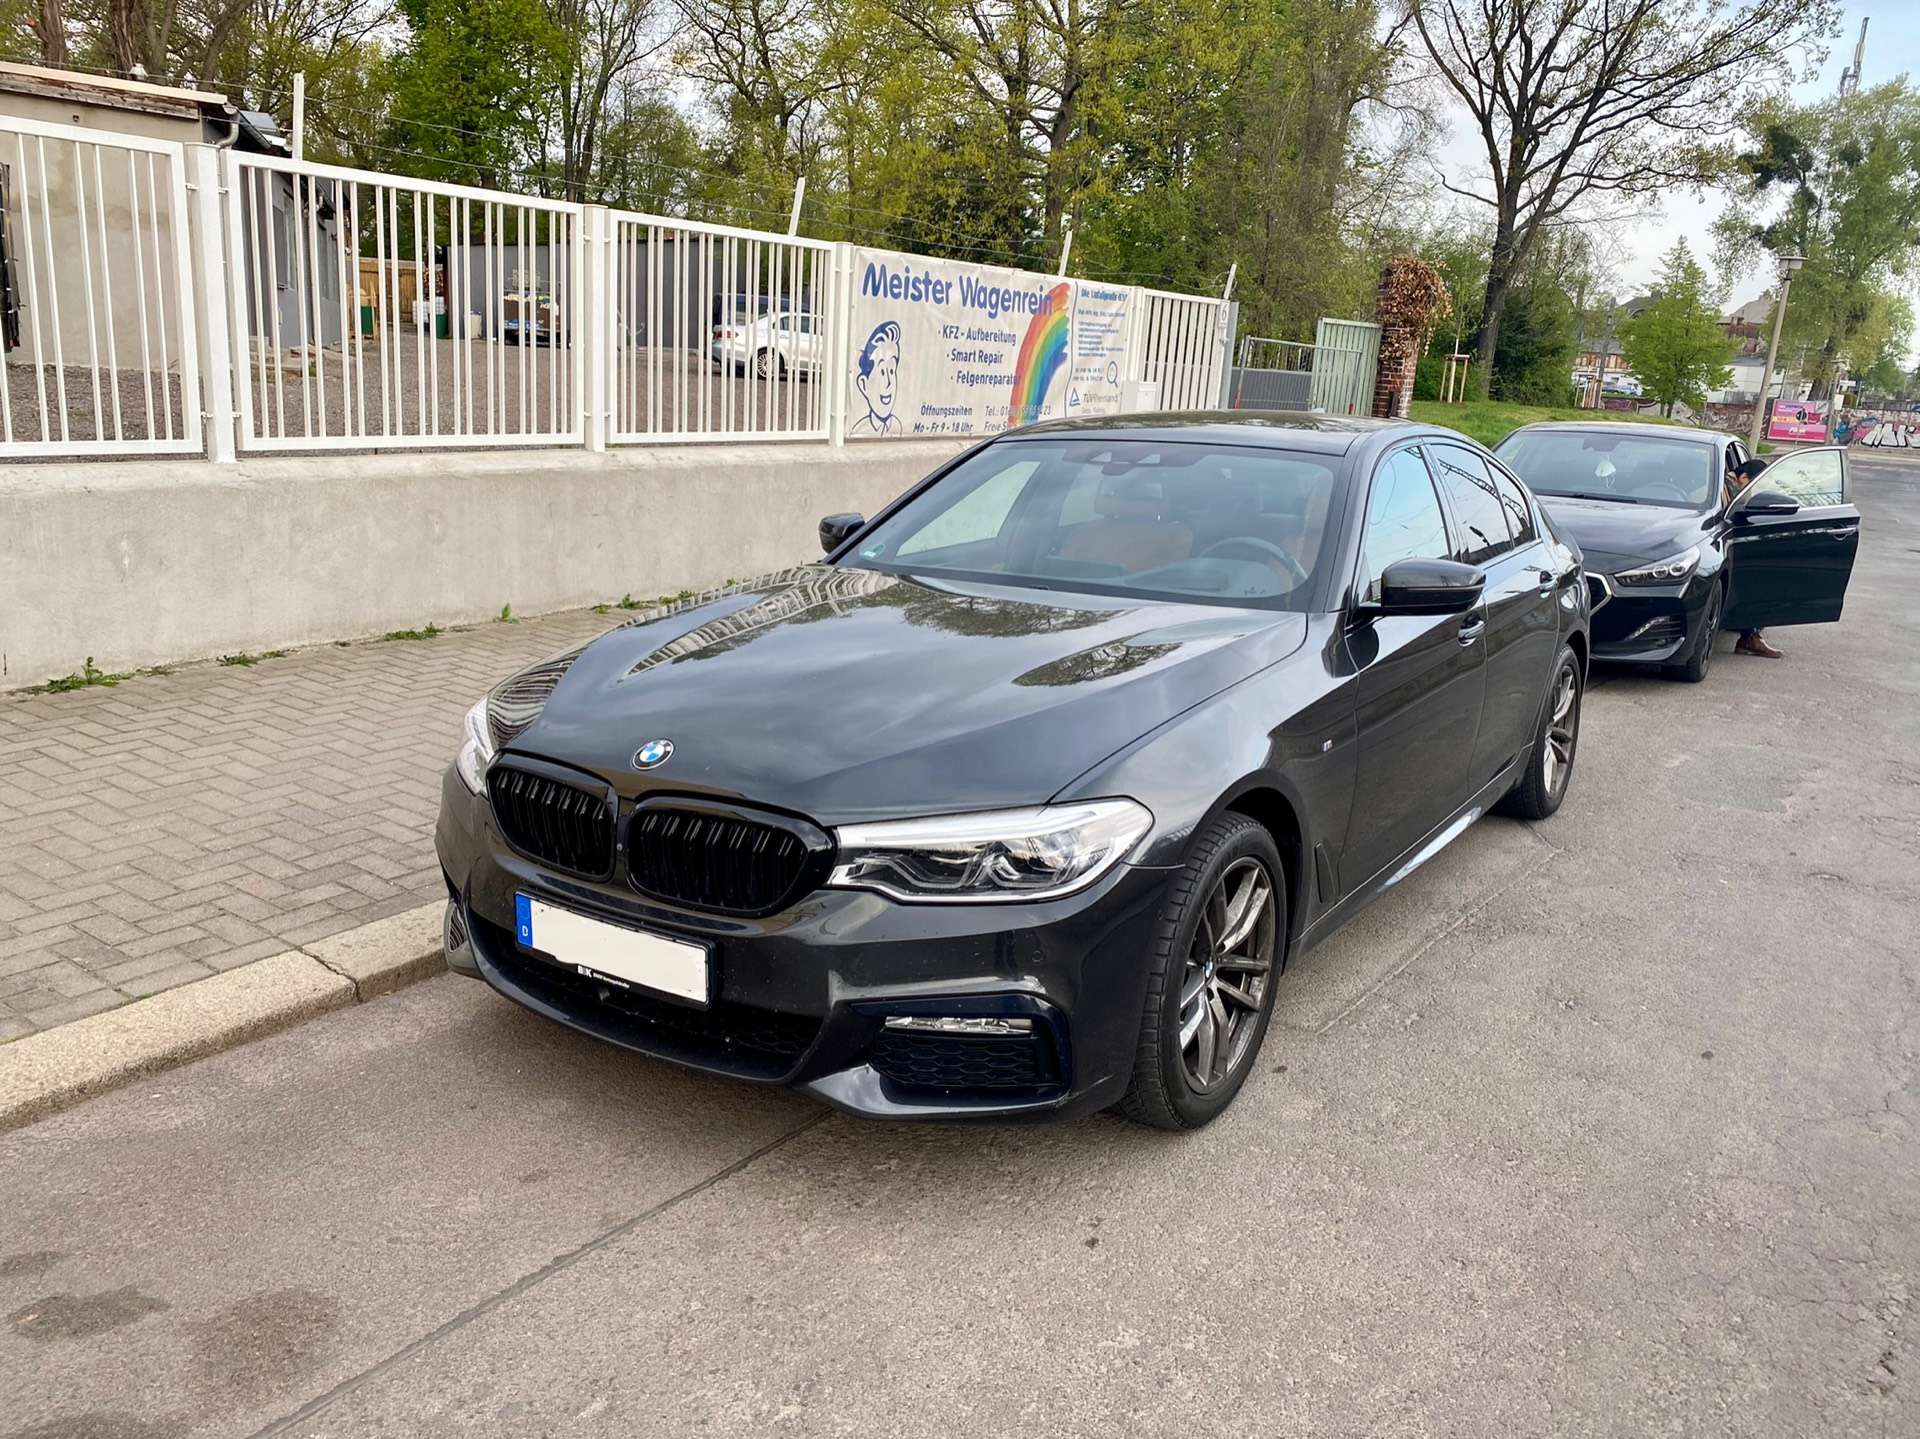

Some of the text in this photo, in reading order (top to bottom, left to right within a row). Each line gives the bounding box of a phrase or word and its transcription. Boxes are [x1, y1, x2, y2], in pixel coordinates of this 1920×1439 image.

[862, 262, 1053, 319] Meister Wagenrein
[942, 324, 960, 340] KFZ
[966, 327, 1017, 346] Aufbereitung
[951, 348, 1003, 366] Smart Repair
[913, 422, 925, 432] Mo
[930, 422, 939, 432] Fr
[940, 422, 946, 432] 9
[951, 422, 960, 432] 18
[961, 422, 974, 432] Uhr
[522, 925, 529, 936] D
